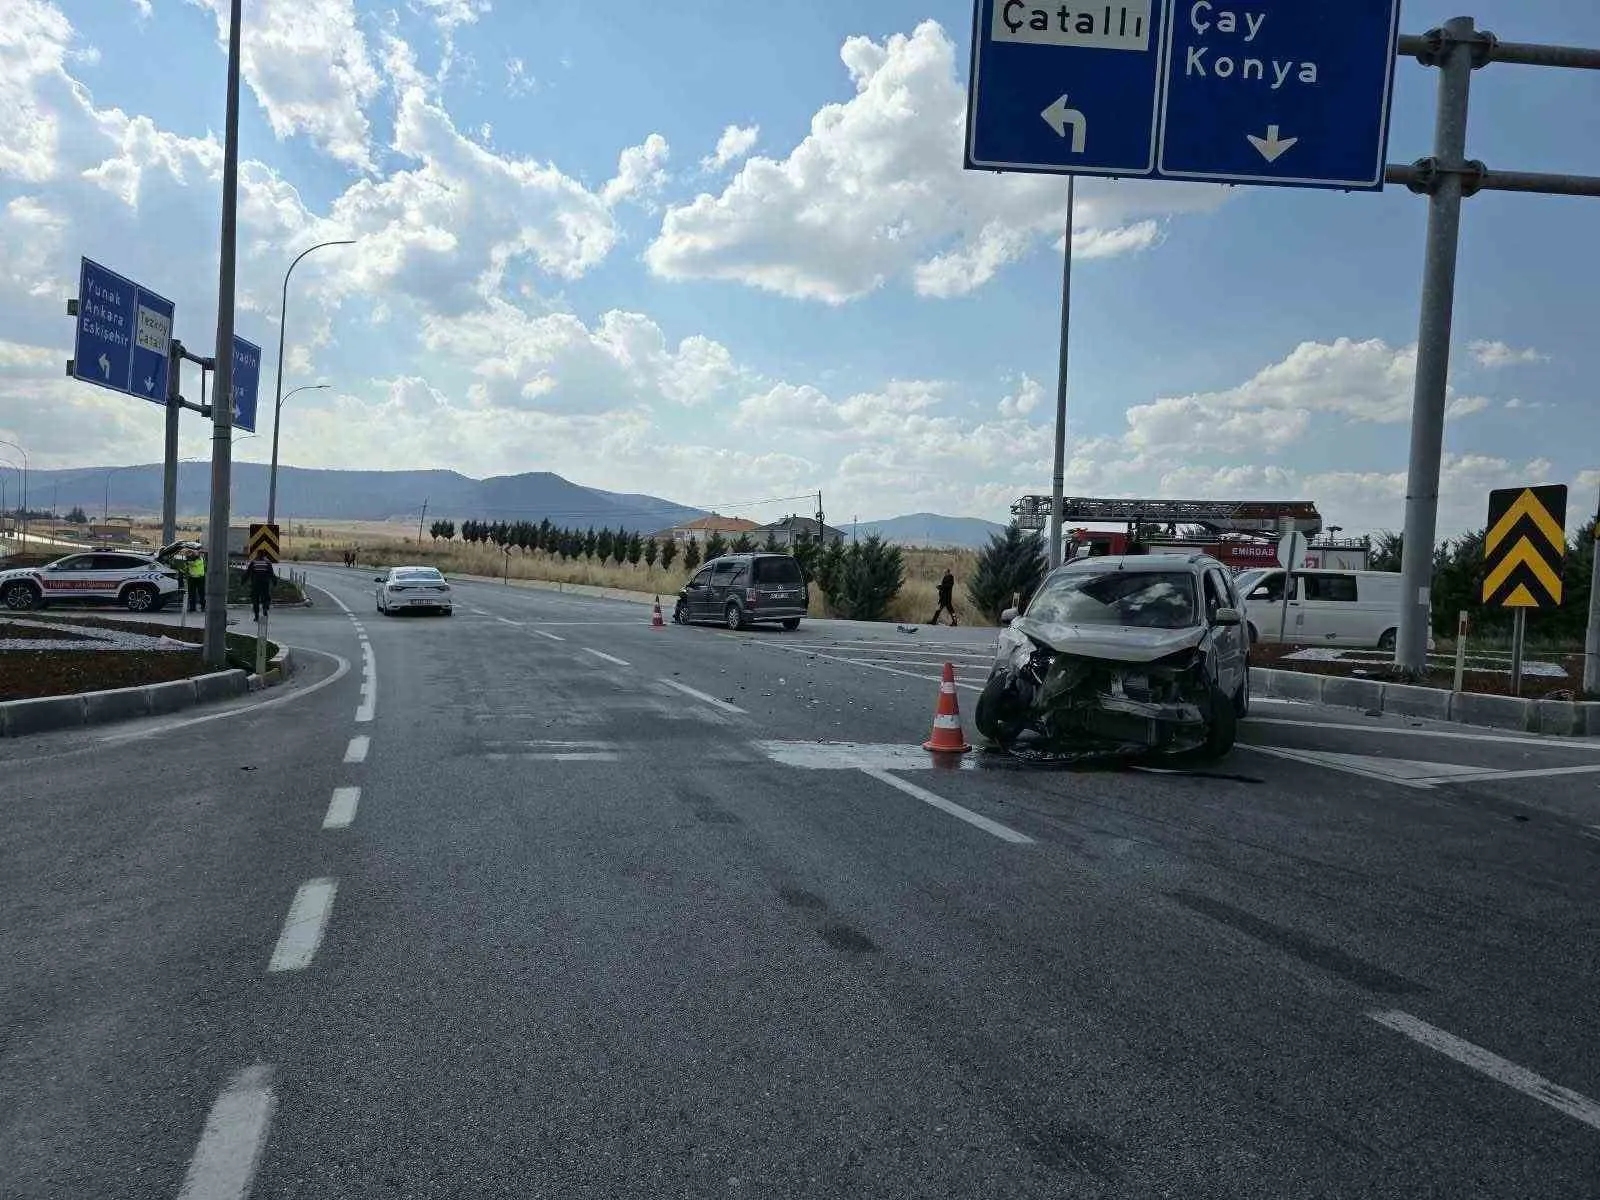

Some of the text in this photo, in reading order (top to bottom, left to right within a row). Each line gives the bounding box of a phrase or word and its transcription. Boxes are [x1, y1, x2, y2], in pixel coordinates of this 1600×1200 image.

[1003, 0, 1142, 37] Çatallı
[1190, 0, 1266, 42] Çay
[1186, 46, 1318, 89] Konya
[87, 277, 121, 306] Yunak
[85, 299, 124, 327] Ankara
[83, 317, 129, 346] Eskişehir
